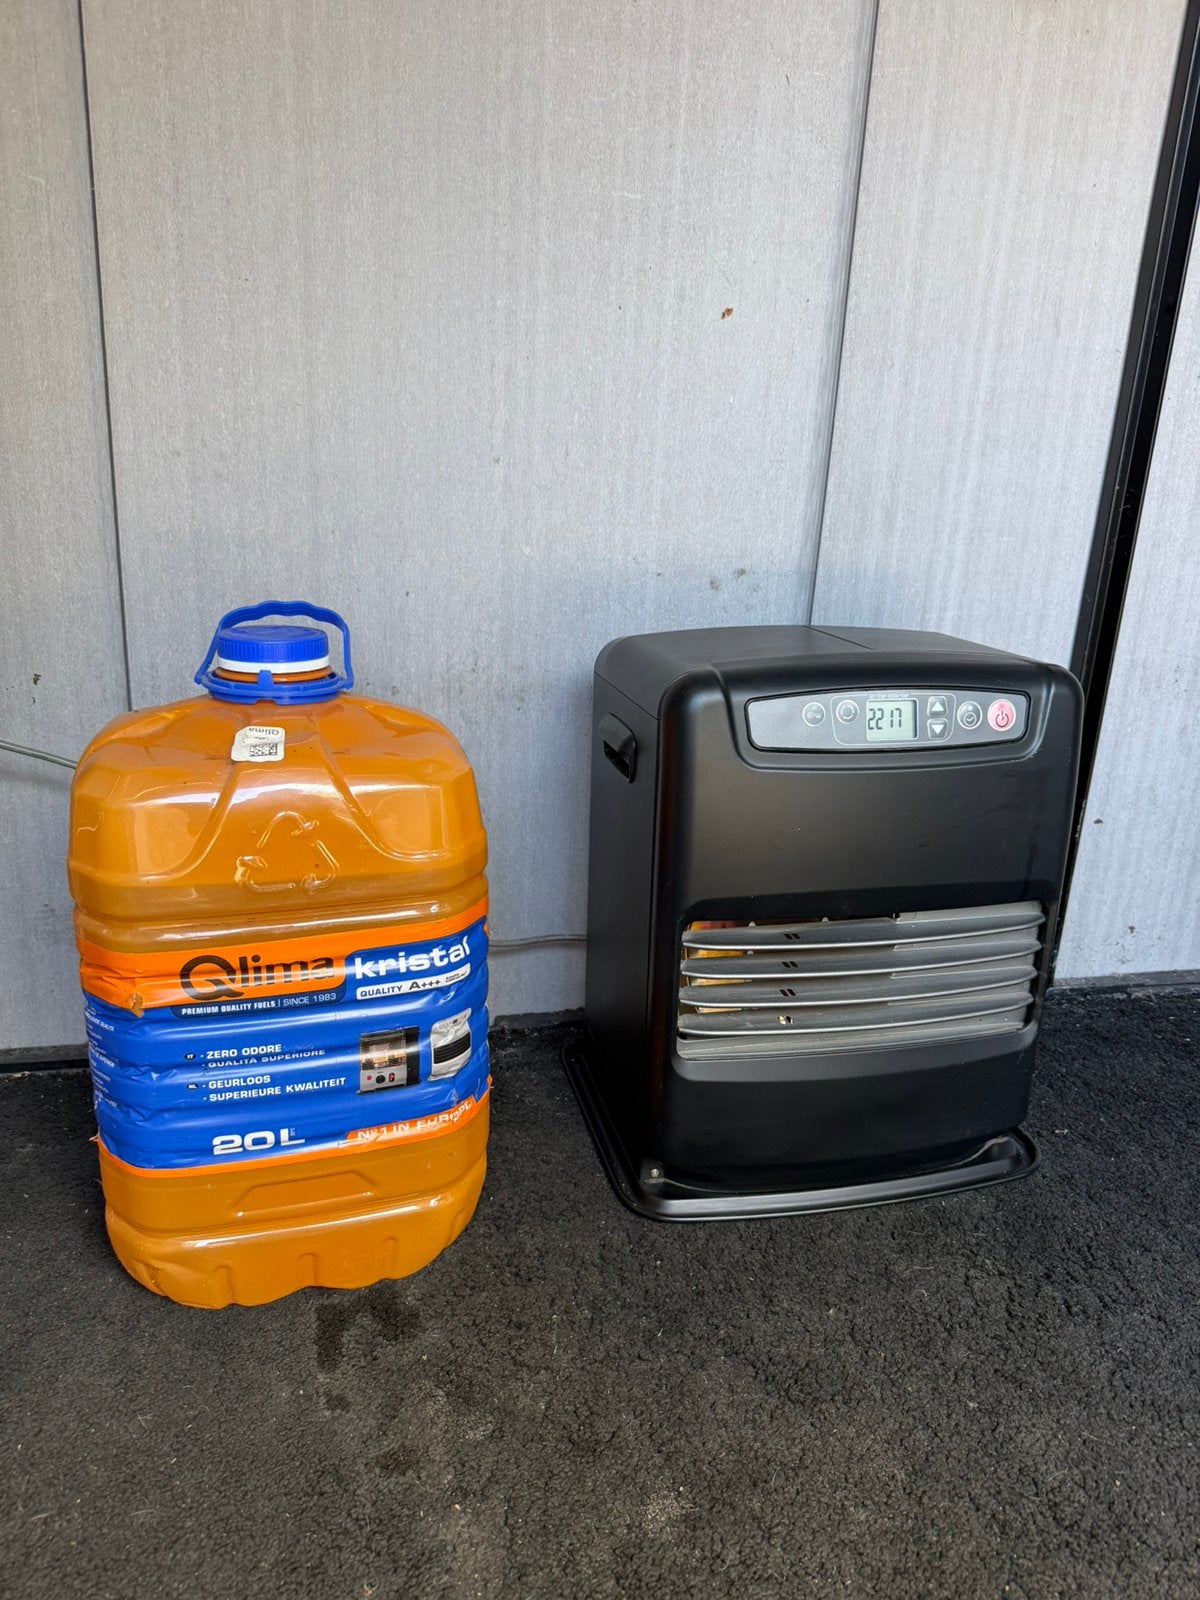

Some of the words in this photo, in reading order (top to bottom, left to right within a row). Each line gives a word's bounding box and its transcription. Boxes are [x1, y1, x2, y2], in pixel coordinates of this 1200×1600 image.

[355, 935, 471, 980] kristal
[179, 954, 334, 1000] Qlima
[360, 985, 403, 998] QUALITY
[181, 1005, 219, 1016] PREMIUM
[221, 1003, 251, 1013] QUALITY
[254, 1000, 276, 1009] FUELS
[283, 996, 309, 1007] SINCE
[312, 993, 337, 1002] 1983
[206, 1049, 238, 1060] ZERO
[242, 1044, 282, 1056] ODORE
[261, 1050, 326, 1062] SUPERIORE
[208, 1075, 271, 1090] GEURLOOS
[209, 1086, 282, 1102] SUPERIEURE
[285, 1077, 347, 1094] KWALITEIT
